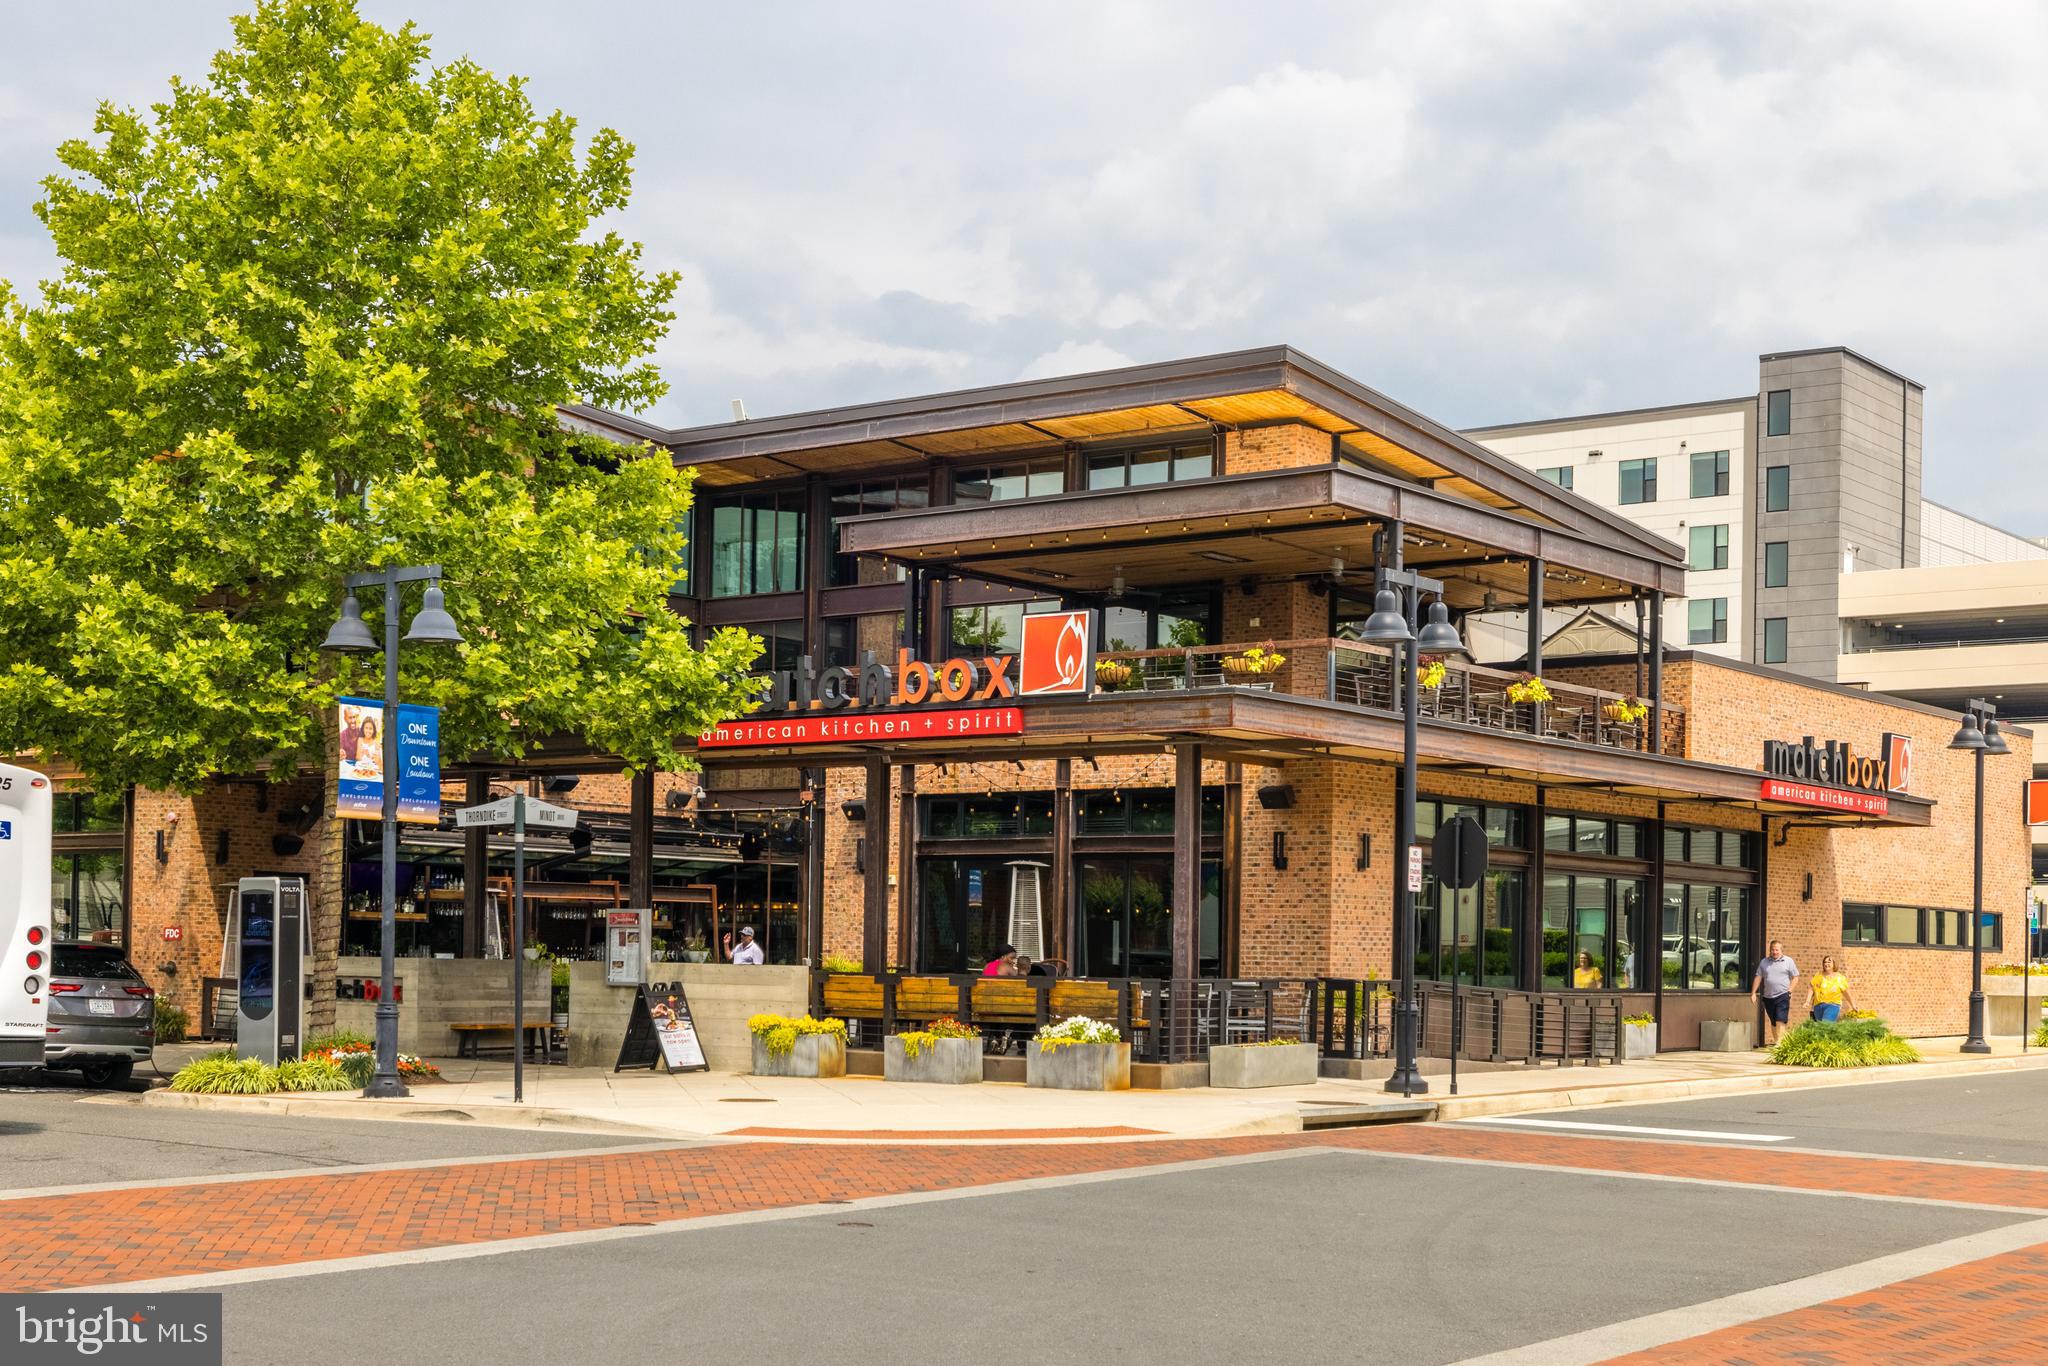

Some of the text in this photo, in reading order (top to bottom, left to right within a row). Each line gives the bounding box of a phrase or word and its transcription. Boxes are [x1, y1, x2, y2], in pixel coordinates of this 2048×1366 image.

[716, 647, 1015, 712] atchbox
[408, 723, 428, 735] ONE
[701, 711, 1013, 742] american kitchen + spirit
[400, 733, 437, 748] Downtown
[410, 755, 430, 767] ONE
[1765, 736, 1887, 791] matchbox
[405, 766, 436, 779] Loudoun
[1771, 784, 1816, 801] american
[1819, 789, 1854, 806] kitchen
[1864, 799, 1888, 812] spirit
[465, 810, 496, 822] THORNDIKE
[539, 811, 556, 822] MINOT
[164, 928, 180, 939] FDC
